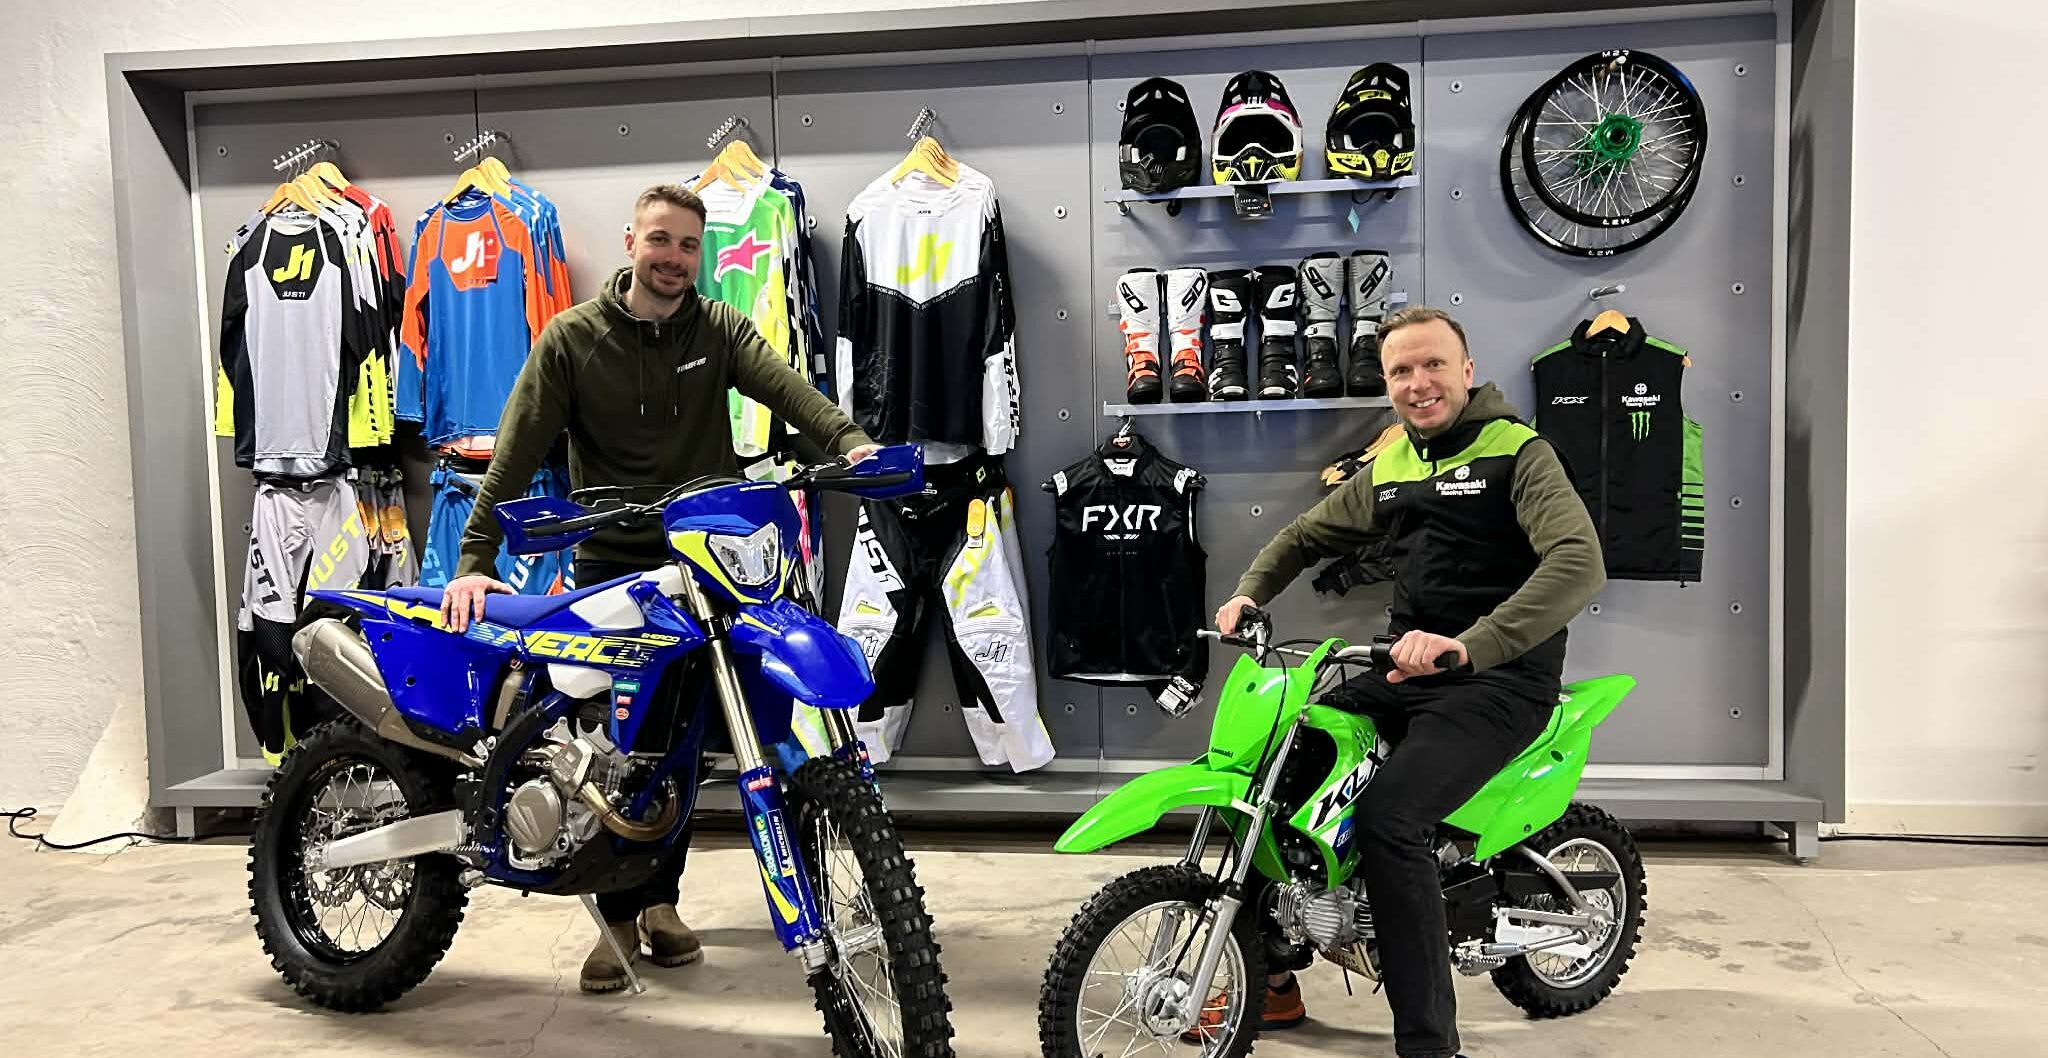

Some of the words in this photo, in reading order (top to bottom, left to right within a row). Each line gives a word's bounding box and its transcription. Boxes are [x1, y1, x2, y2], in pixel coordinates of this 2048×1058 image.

[272, 243, 316, 283] J1
[896, 232, 955, 285] J1
[1621, 394, 1661, 403] Kawasaki
[1435, 479, 1487, 491] Kawasaki
[1082, 504, 1162, 533] FXR
[974, 640, 1008, 664] J1
[773, 815, 790, 858] MICHELIN
[758, 829, 779, 879] MOTOREX
